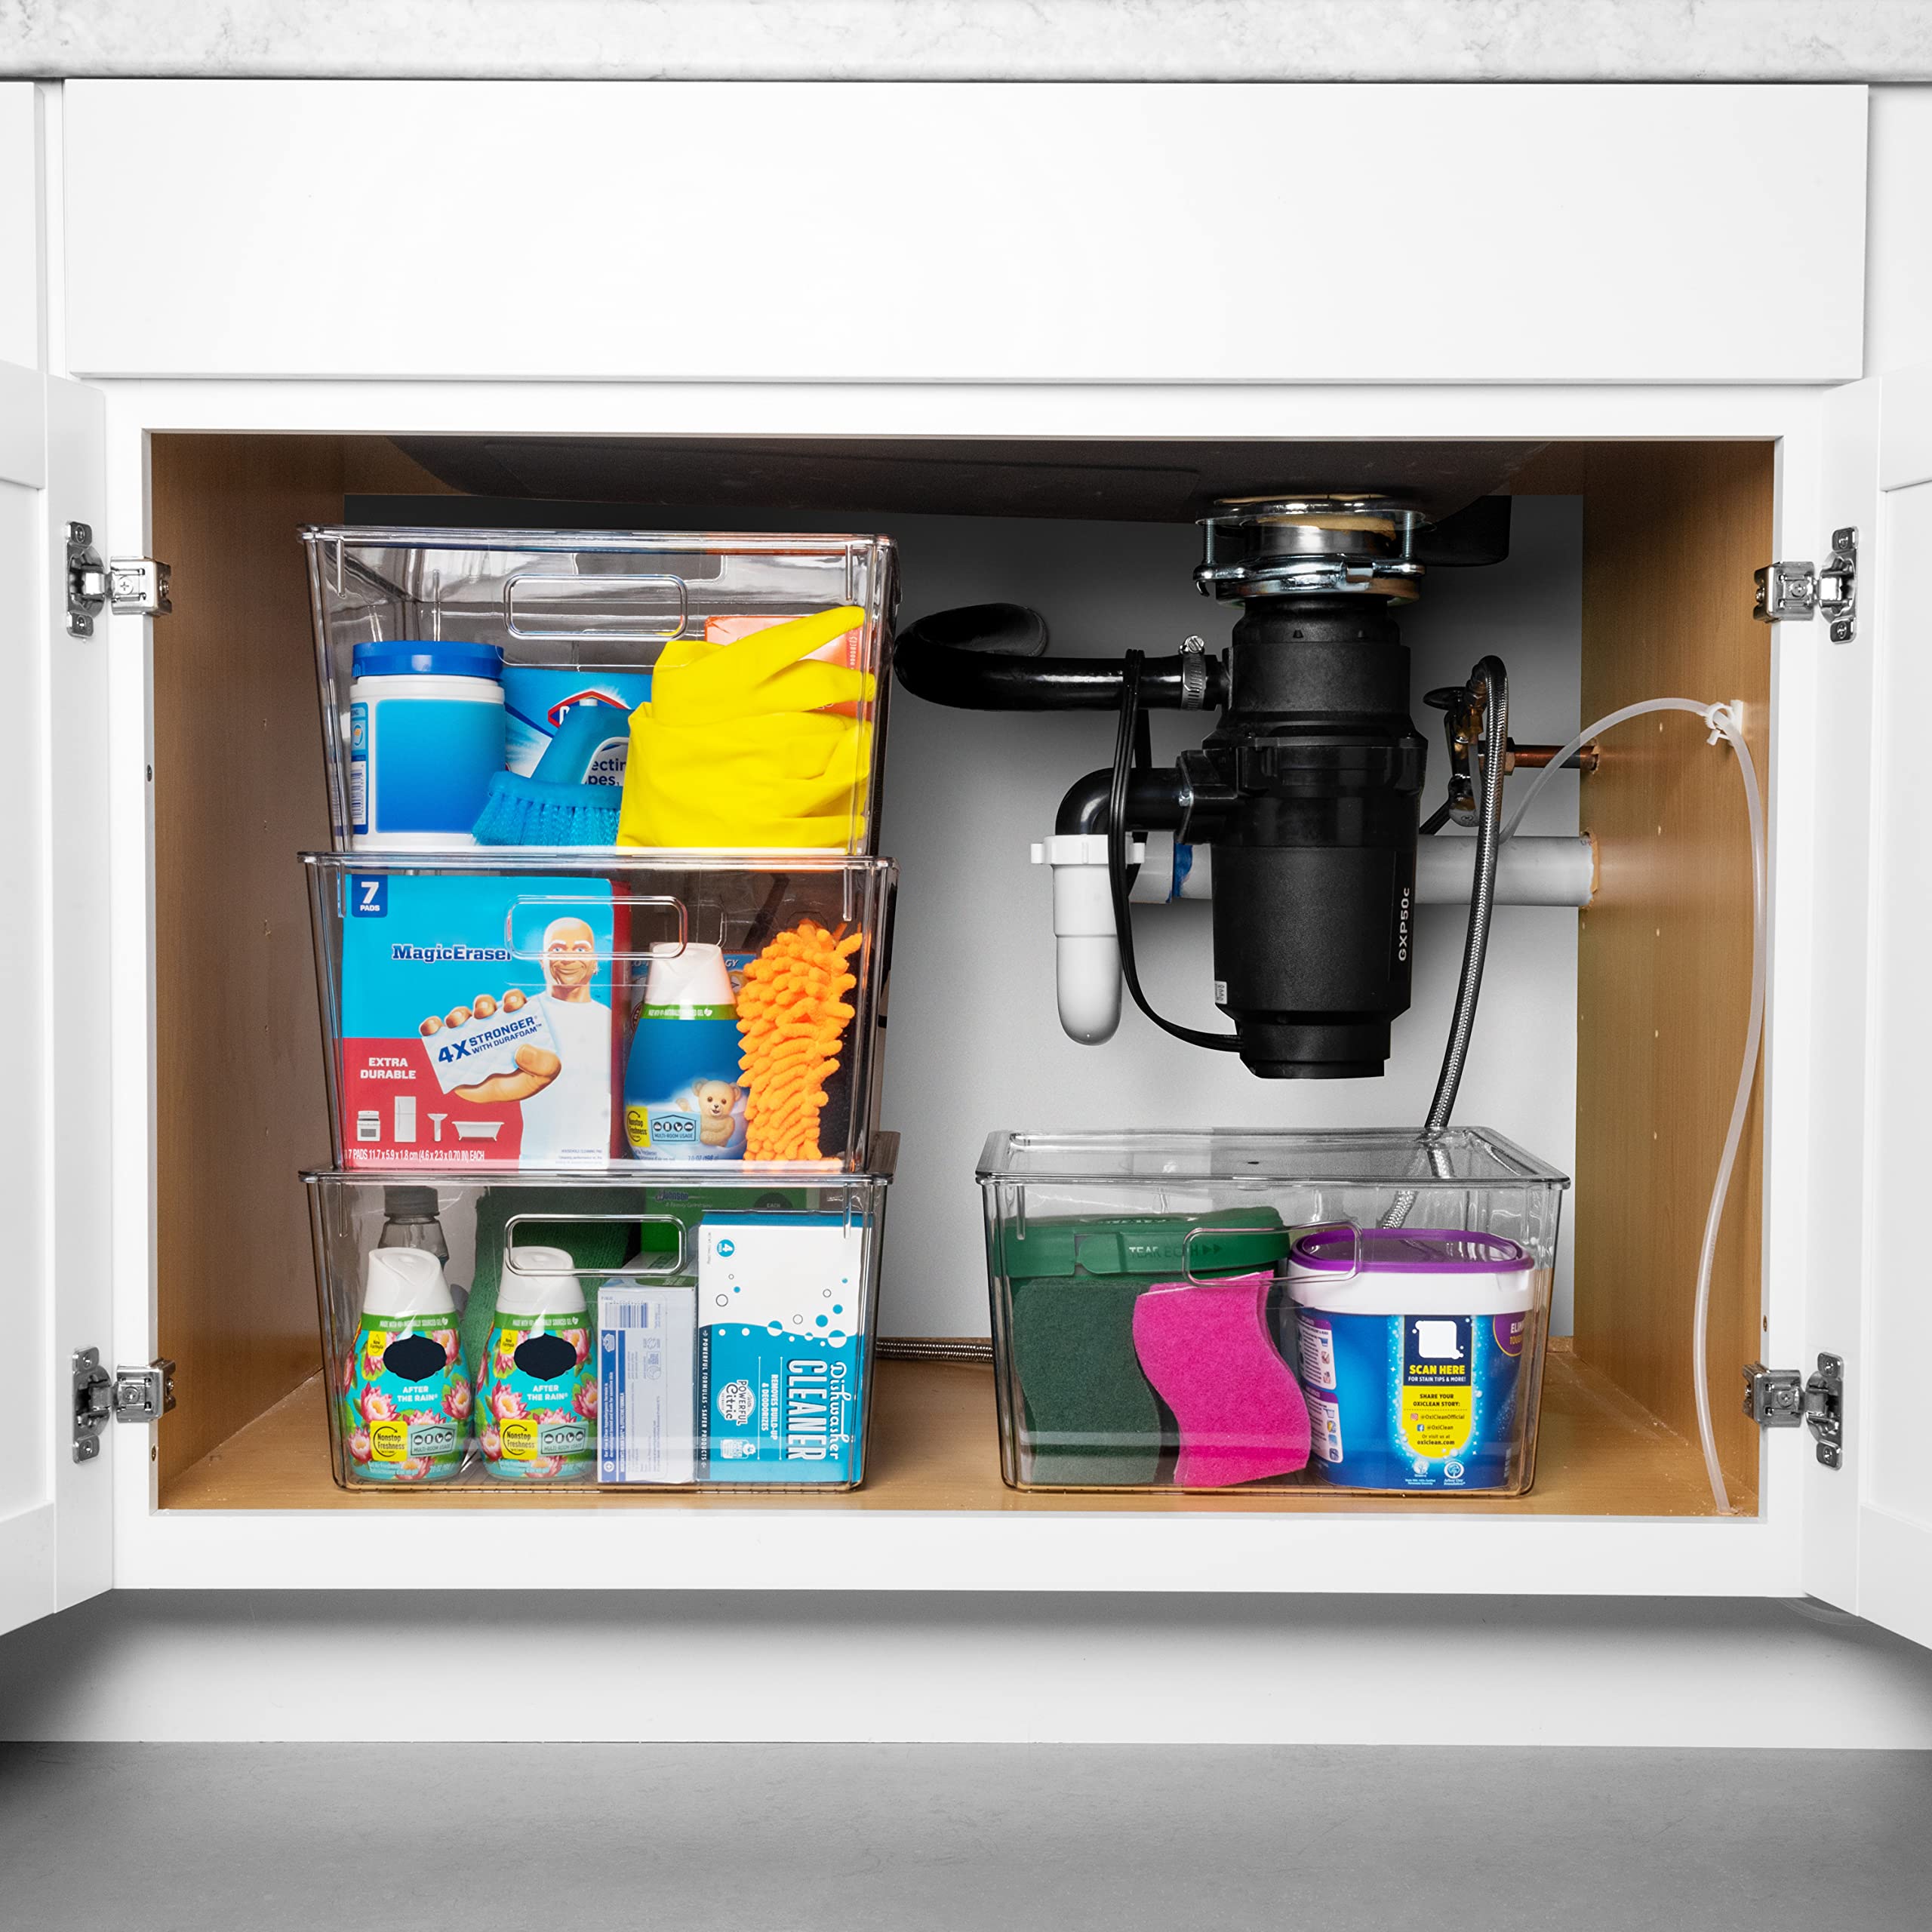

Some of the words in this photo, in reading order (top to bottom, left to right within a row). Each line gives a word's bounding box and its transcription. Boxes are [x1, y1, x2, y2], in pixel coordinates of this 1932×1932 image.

[361, 881, 379, 904] 7
[1398, 888, 1410, 961] GXP50c
[438, 1038, 471, 1063] 4X
[472, 1041, 493, 1054] WITH
[368, 1057, 408, 1067] EXTRA
[360, 1069, 417, 1079] DURABLE
[353, 1149, 368, 1160] PADS
[369, 1150, 381, 1160] 11.7
[386, 1150, 395, 1160] 5.9
[400, 1150, 408, 1160] 1.8
[435, 1150, 444, 1161] 2.3
[469, 1151, 485, 1161] EACH
[722, 1243, 734, 1252] 4
[1409, 1364, 1437, 1374] SCAN
[1439, 1365, 1466, 1375] HERE
[402, 1386, 429, 1394] AFTER
[771, 1374, 779, 1406] REMOVES
[726, 1384, 738, 1420] Citric
[737, 1380, 747, 1425] POWERFUL
[761, 1389, 769, 1432] DEODORIZES
[786, 1359, 828, 1460] CLEANER
[829, 1361, 851, 1460] Dishwasher
[770, 1407, 779, 1440] BUILD-UP
[377, 1433, 401, 1443] Nonstop
[506, 1432, 531, 1441] Nonstop
[377, 1441, 405, 1450] Freshness
[507, 1439, 535, 1448] Freshness
